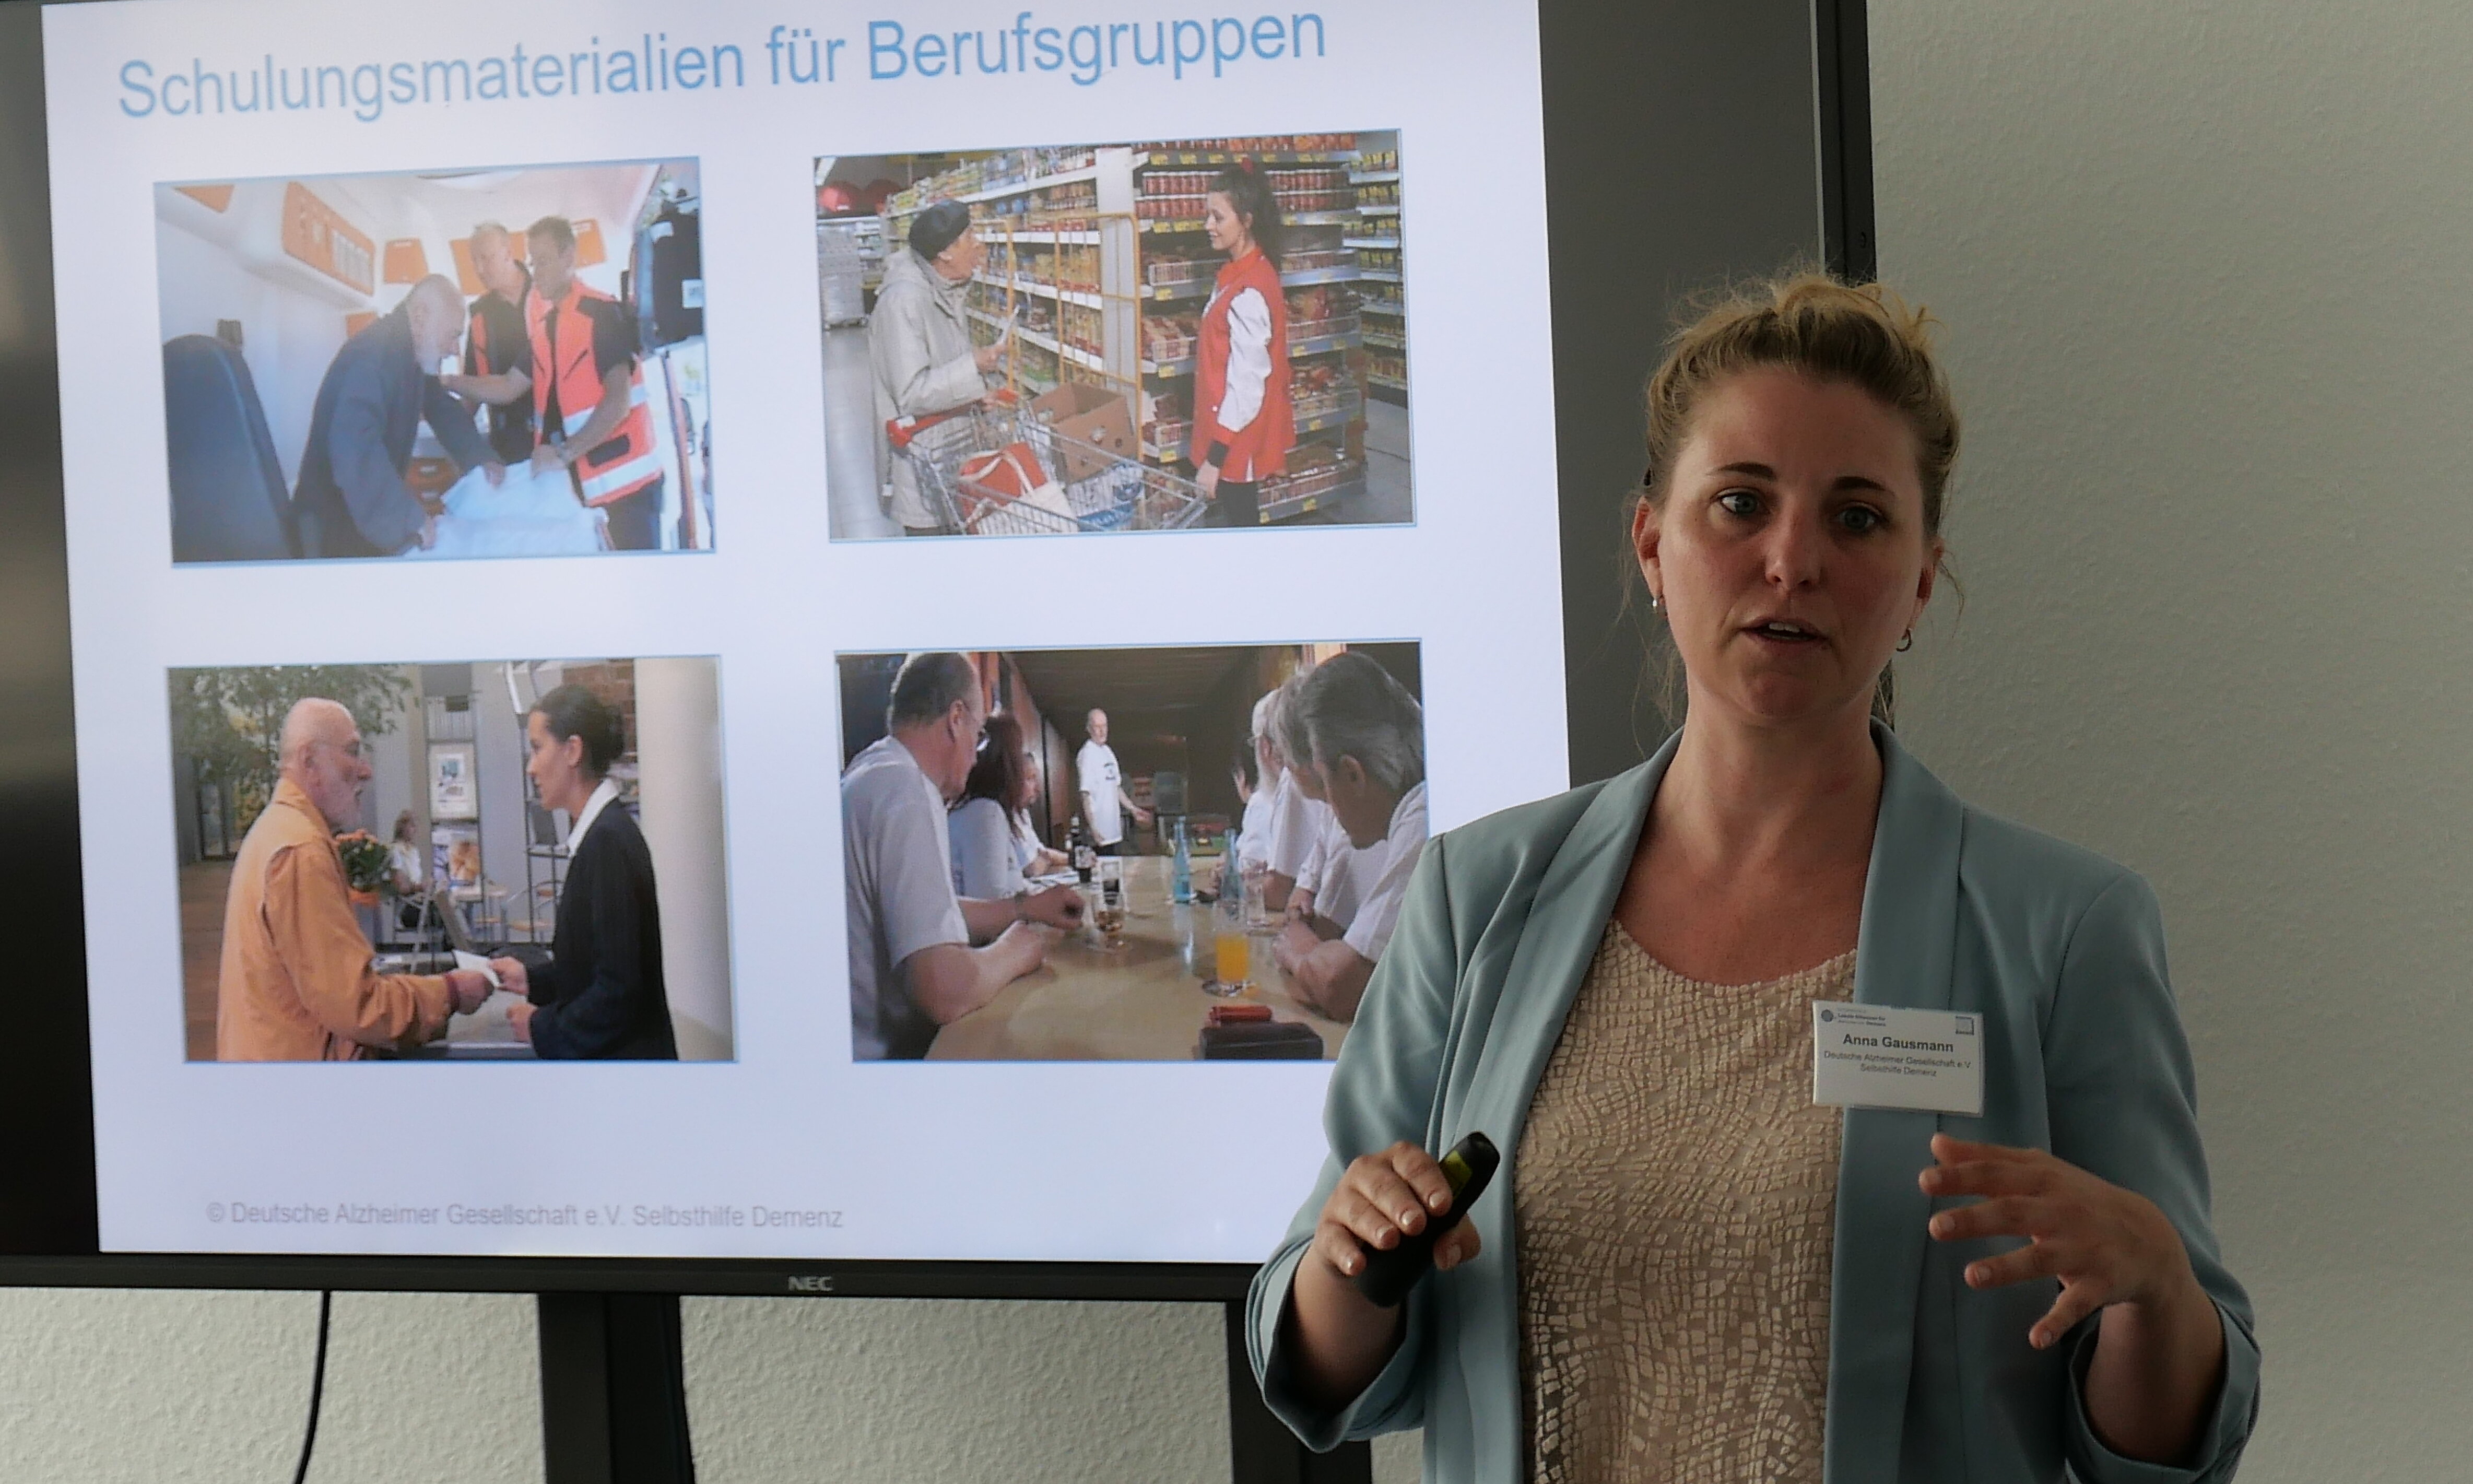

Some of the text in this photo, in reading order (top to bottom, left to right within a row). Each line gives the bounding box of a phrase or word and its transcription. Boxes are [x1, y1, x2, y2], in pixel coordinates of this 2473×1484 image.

[118, 11, 1325, 122] Schulungsmaterialien für Berufsgruppen
[1843, 1033, 1954, 1052] Anna Gausmann
[231, 1202, 328, 1223] Deutsche
[335, 1203, 439, 1224] Alzheimer
[447, 1203, 578, 1226] Gesellschaft
[585, 1205, 627, 1226] e.V.
[633, 1205, 744, 1227] Selbsthilfe
[752, 1206, 844, 1228] Demenz
[788, 1276, 833, 1291] NEC
